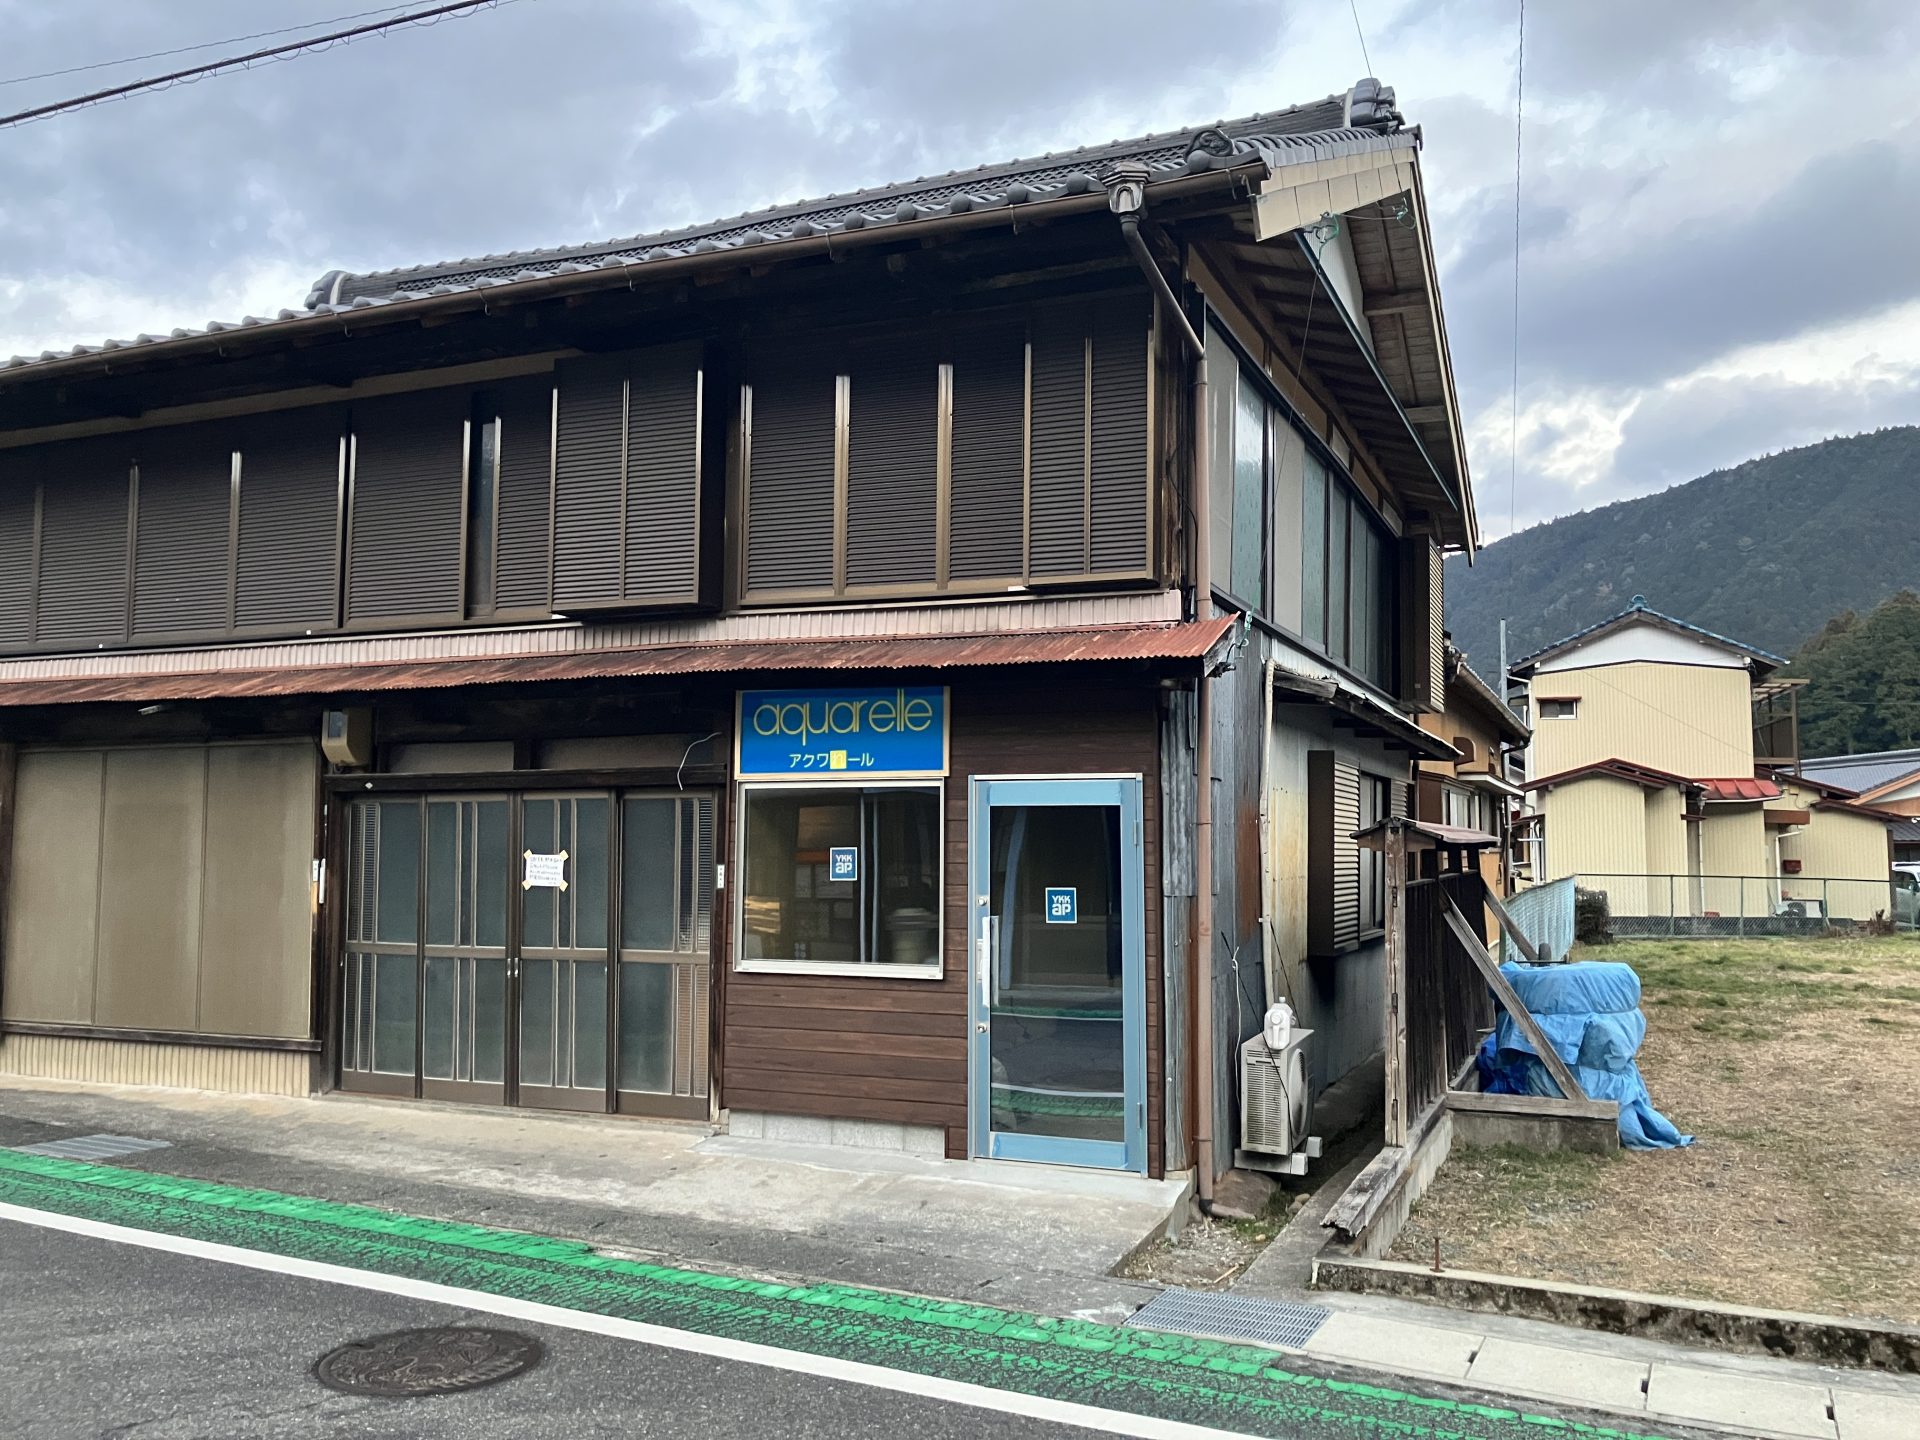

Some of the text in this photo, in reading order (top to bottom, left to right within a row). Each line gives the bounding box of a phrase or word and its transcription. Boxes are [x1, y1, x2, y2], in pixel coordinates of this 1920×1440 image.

[753, 688, 933, 746] aquarelle
[835, 854, 853, 862] YKK
[1051, 895, 1070, 904] YKK
